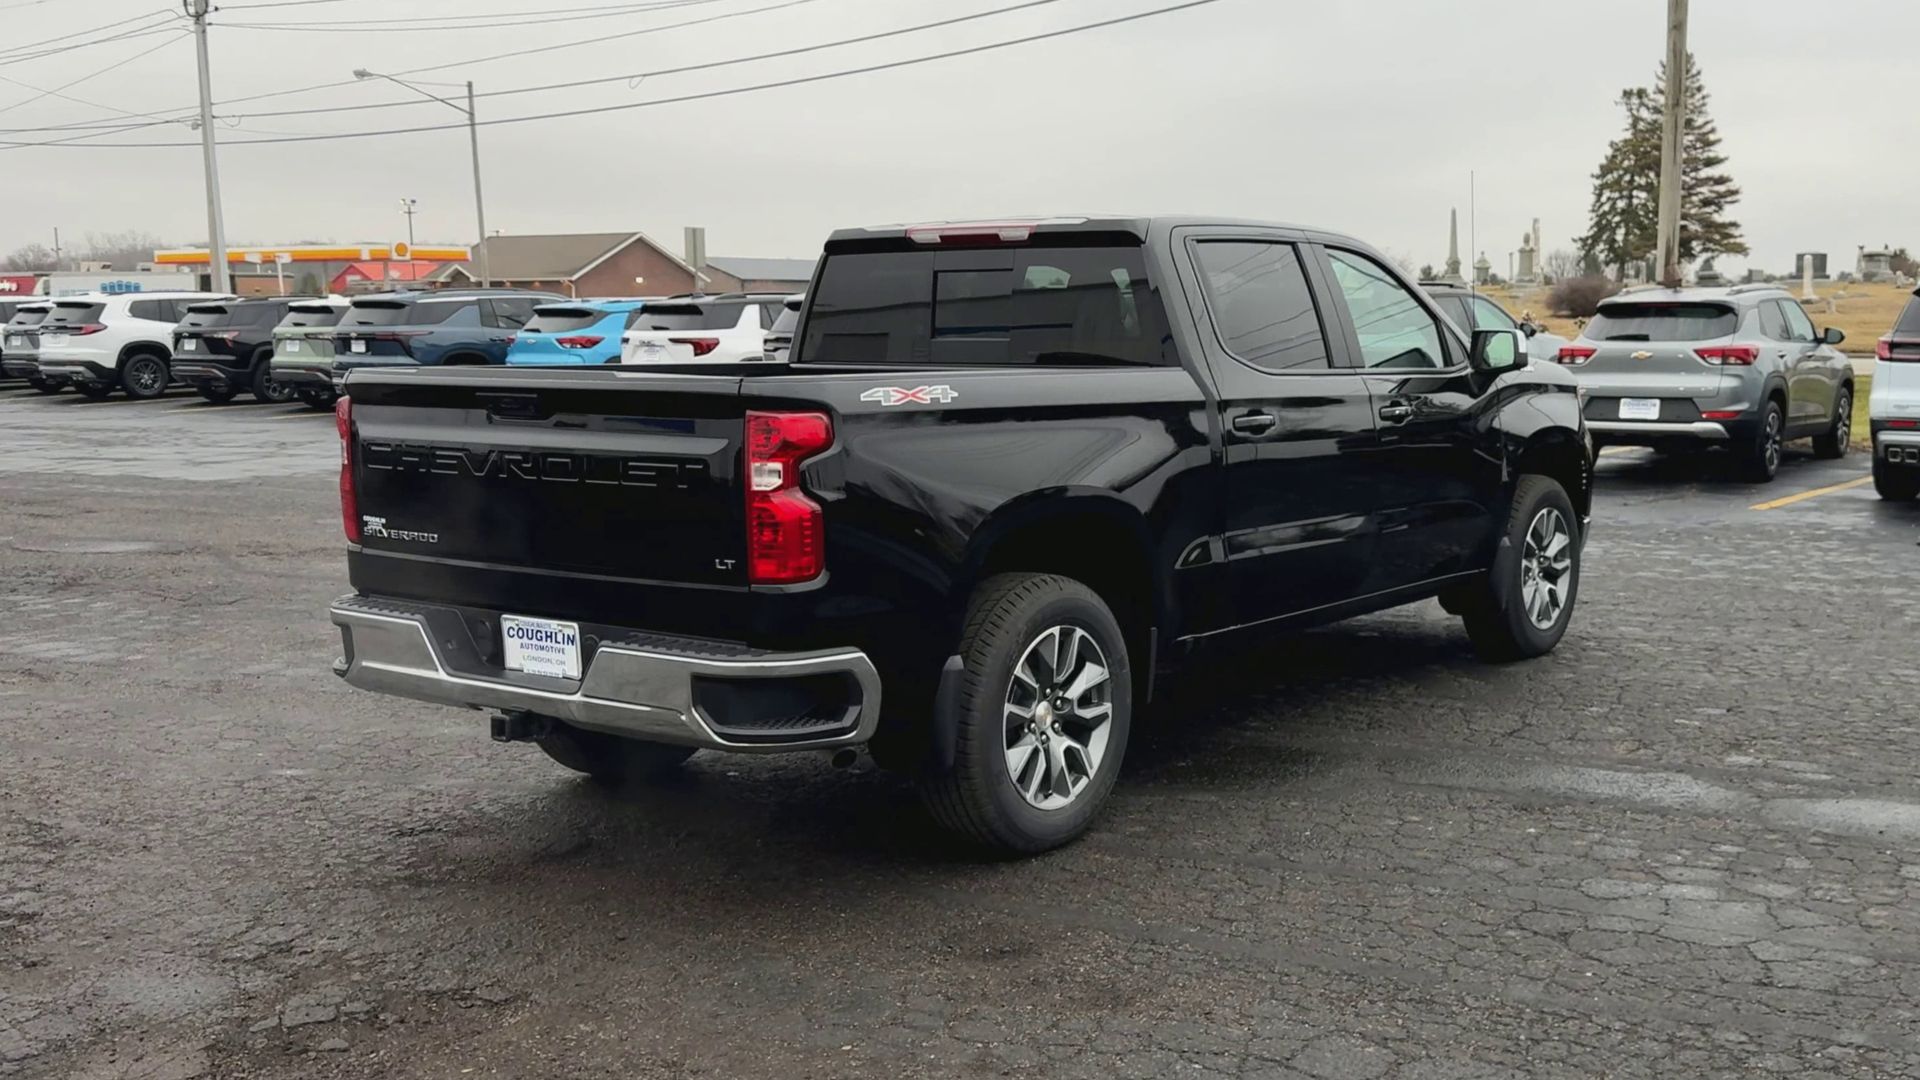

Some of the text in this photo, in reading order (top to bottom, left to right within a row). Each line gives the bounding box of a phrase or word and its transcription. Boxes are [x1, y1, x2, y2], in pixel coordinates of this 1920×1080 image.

[367, 443, 705, 489] CHEVROLET
[363, 526, 438, 543] SILVERADO
[715, 559, 736, 570] LT
[506, 626, 576, 647] COUGHLIN
[519, 642, 566, 655] AUTOMOTIVE
